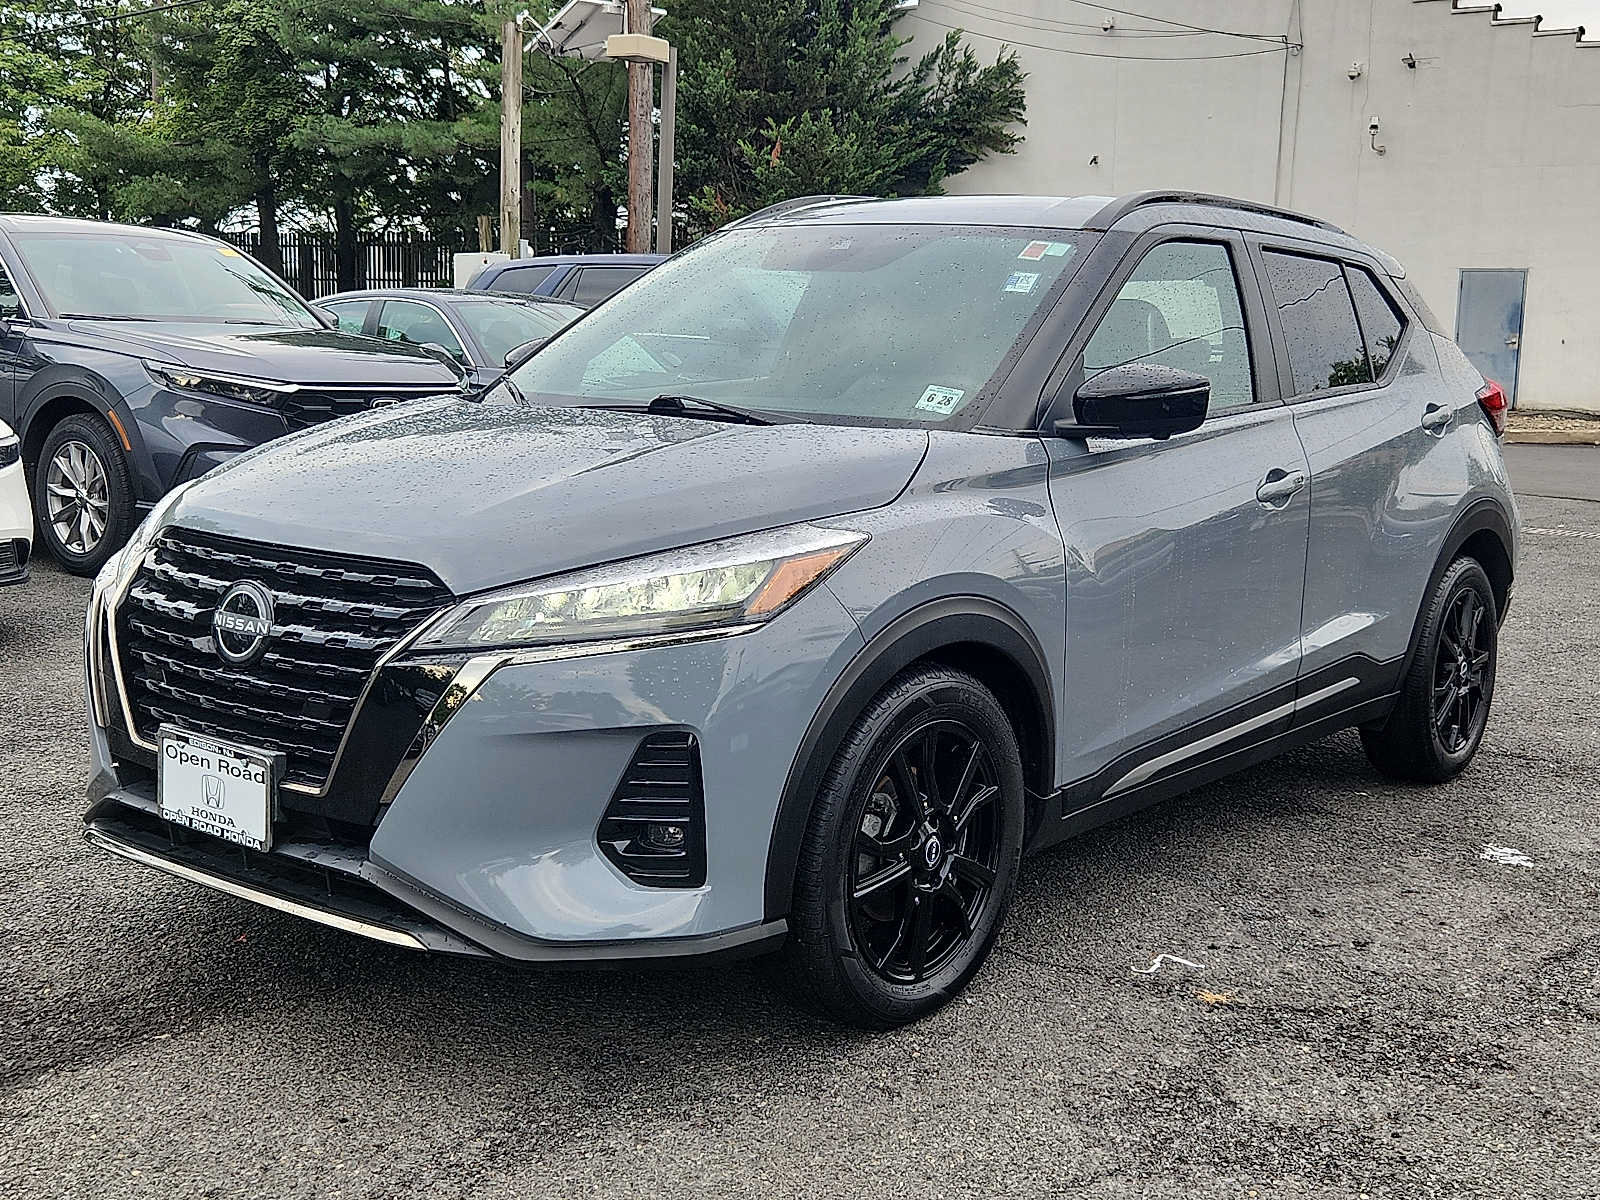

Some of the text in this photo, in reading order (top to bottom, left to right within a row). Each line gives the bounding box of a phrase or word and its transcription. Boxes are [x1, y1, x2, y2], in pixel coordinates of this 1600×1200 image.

[926, 393, 953, 406] 6 28
[214, 611, 269, 634] NISSAN
[165, 744, 265, 784] Open Road
[223, 748, 235, 758] NJ
[191, 806, 237, 828] HONDA
[162, 811, 262, 851] OPEN ROAD HONDA
